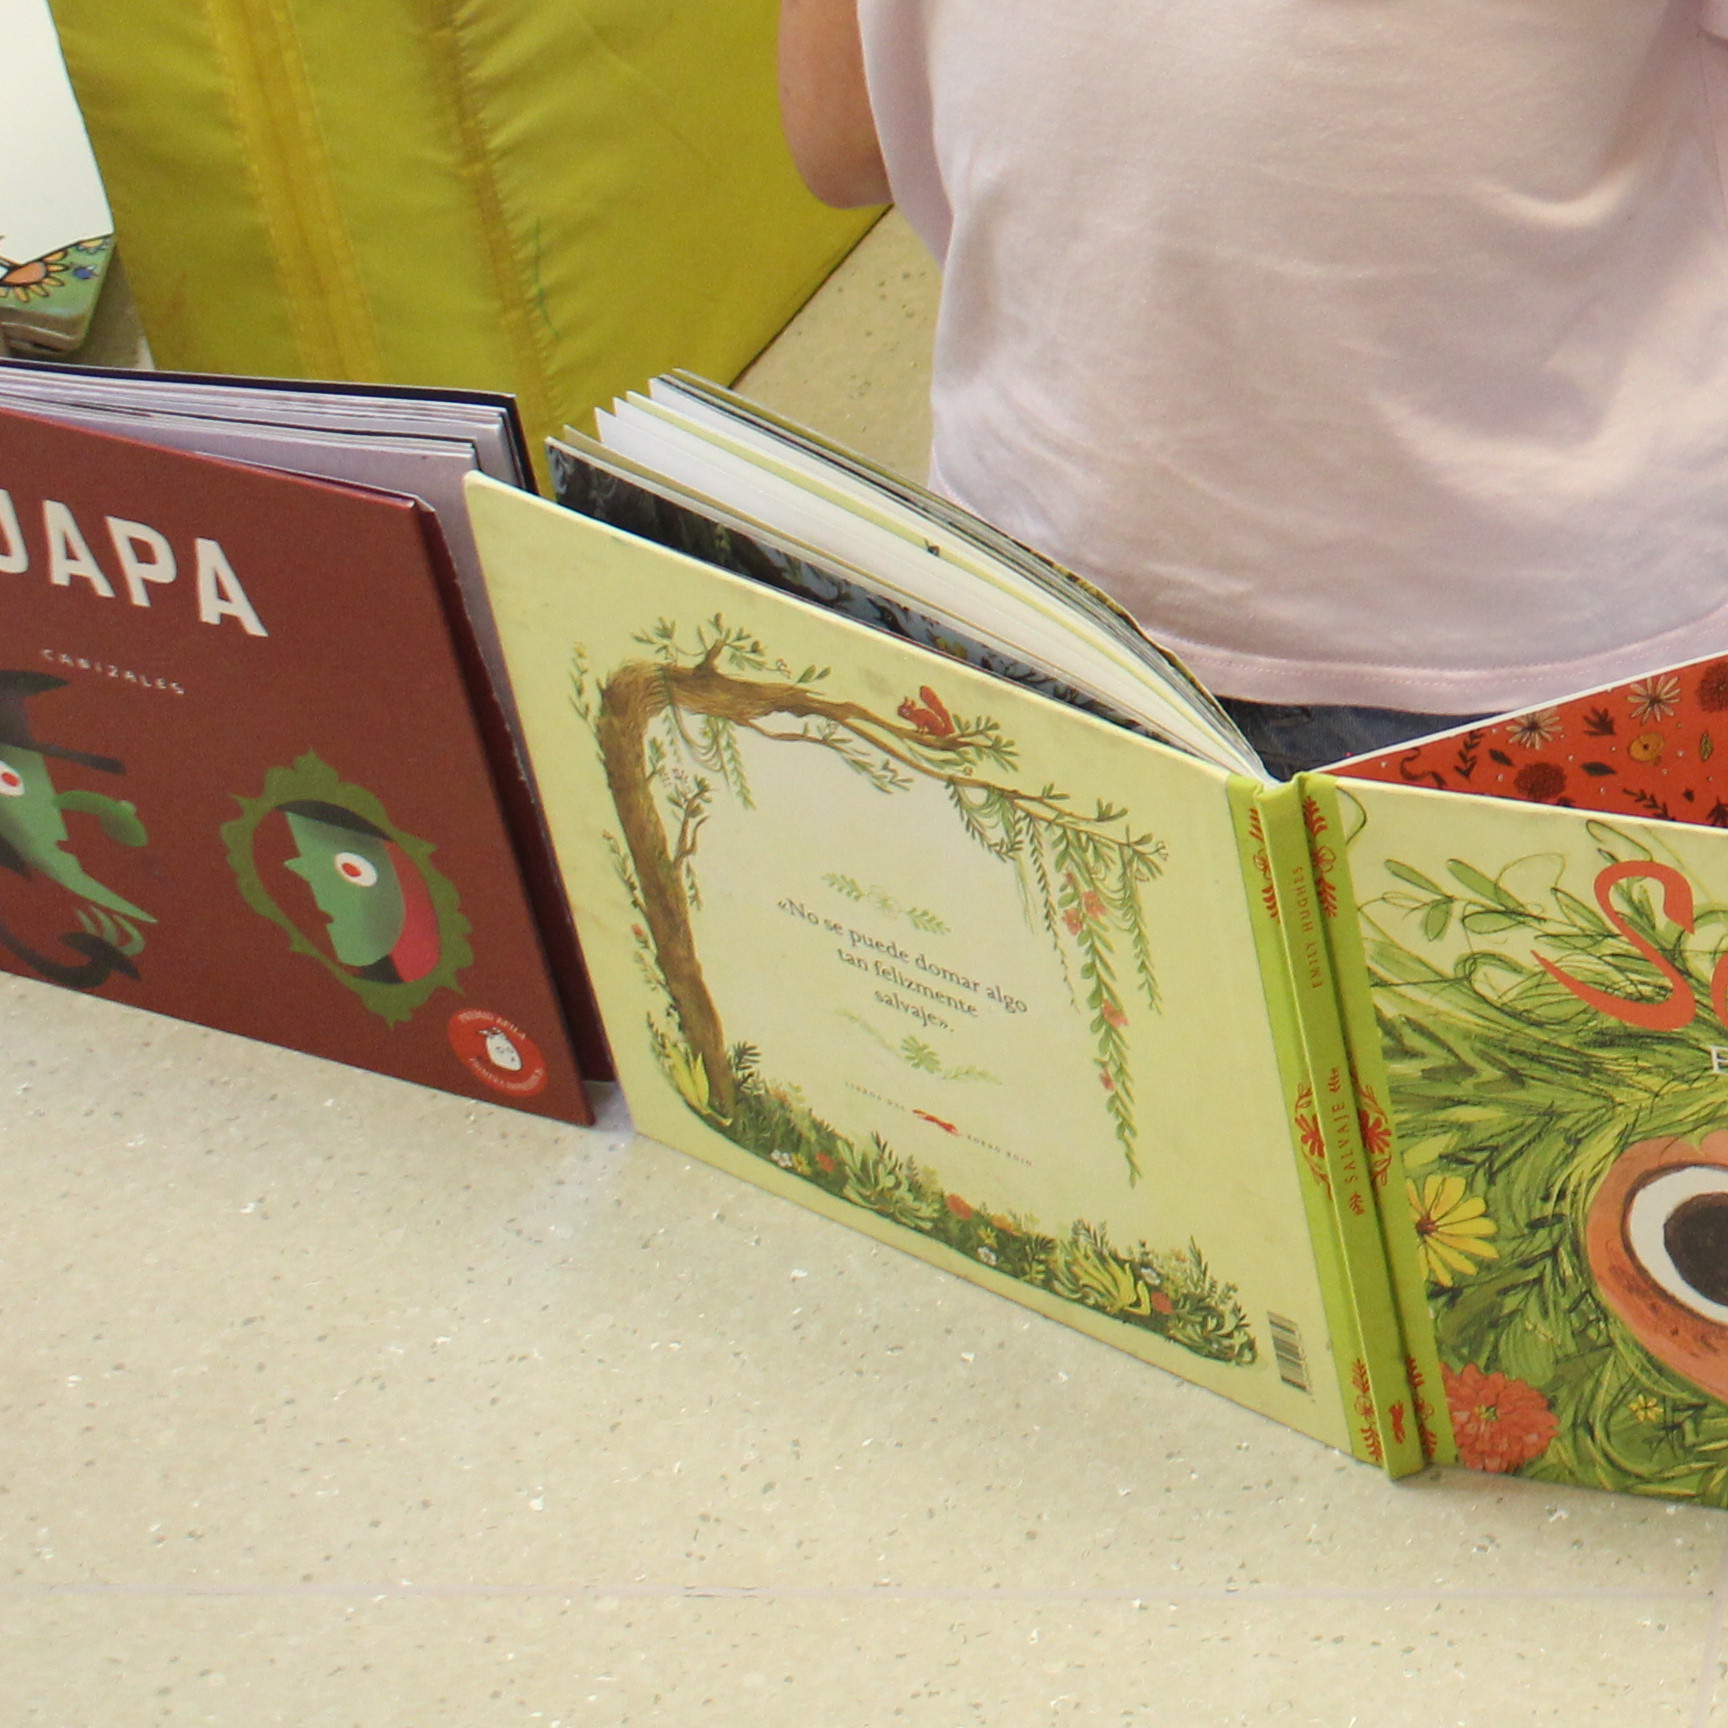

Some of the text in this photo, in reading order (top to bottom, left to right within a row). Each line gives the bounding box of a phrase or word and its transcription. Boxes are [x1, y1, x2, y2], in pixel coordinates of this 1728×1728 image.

[824, 919, 844, 936] se
[848, 929, 910, 963] puede
[915, 953, 980, 992] domar
[986, 984, 1028, 1014] algo
[1292, 866, 1323, 989] EMILY HUGHES
[837, 948, 978, 1016] tan felizmente
[1332, 1101, 1358, 1184] SALVAJE
